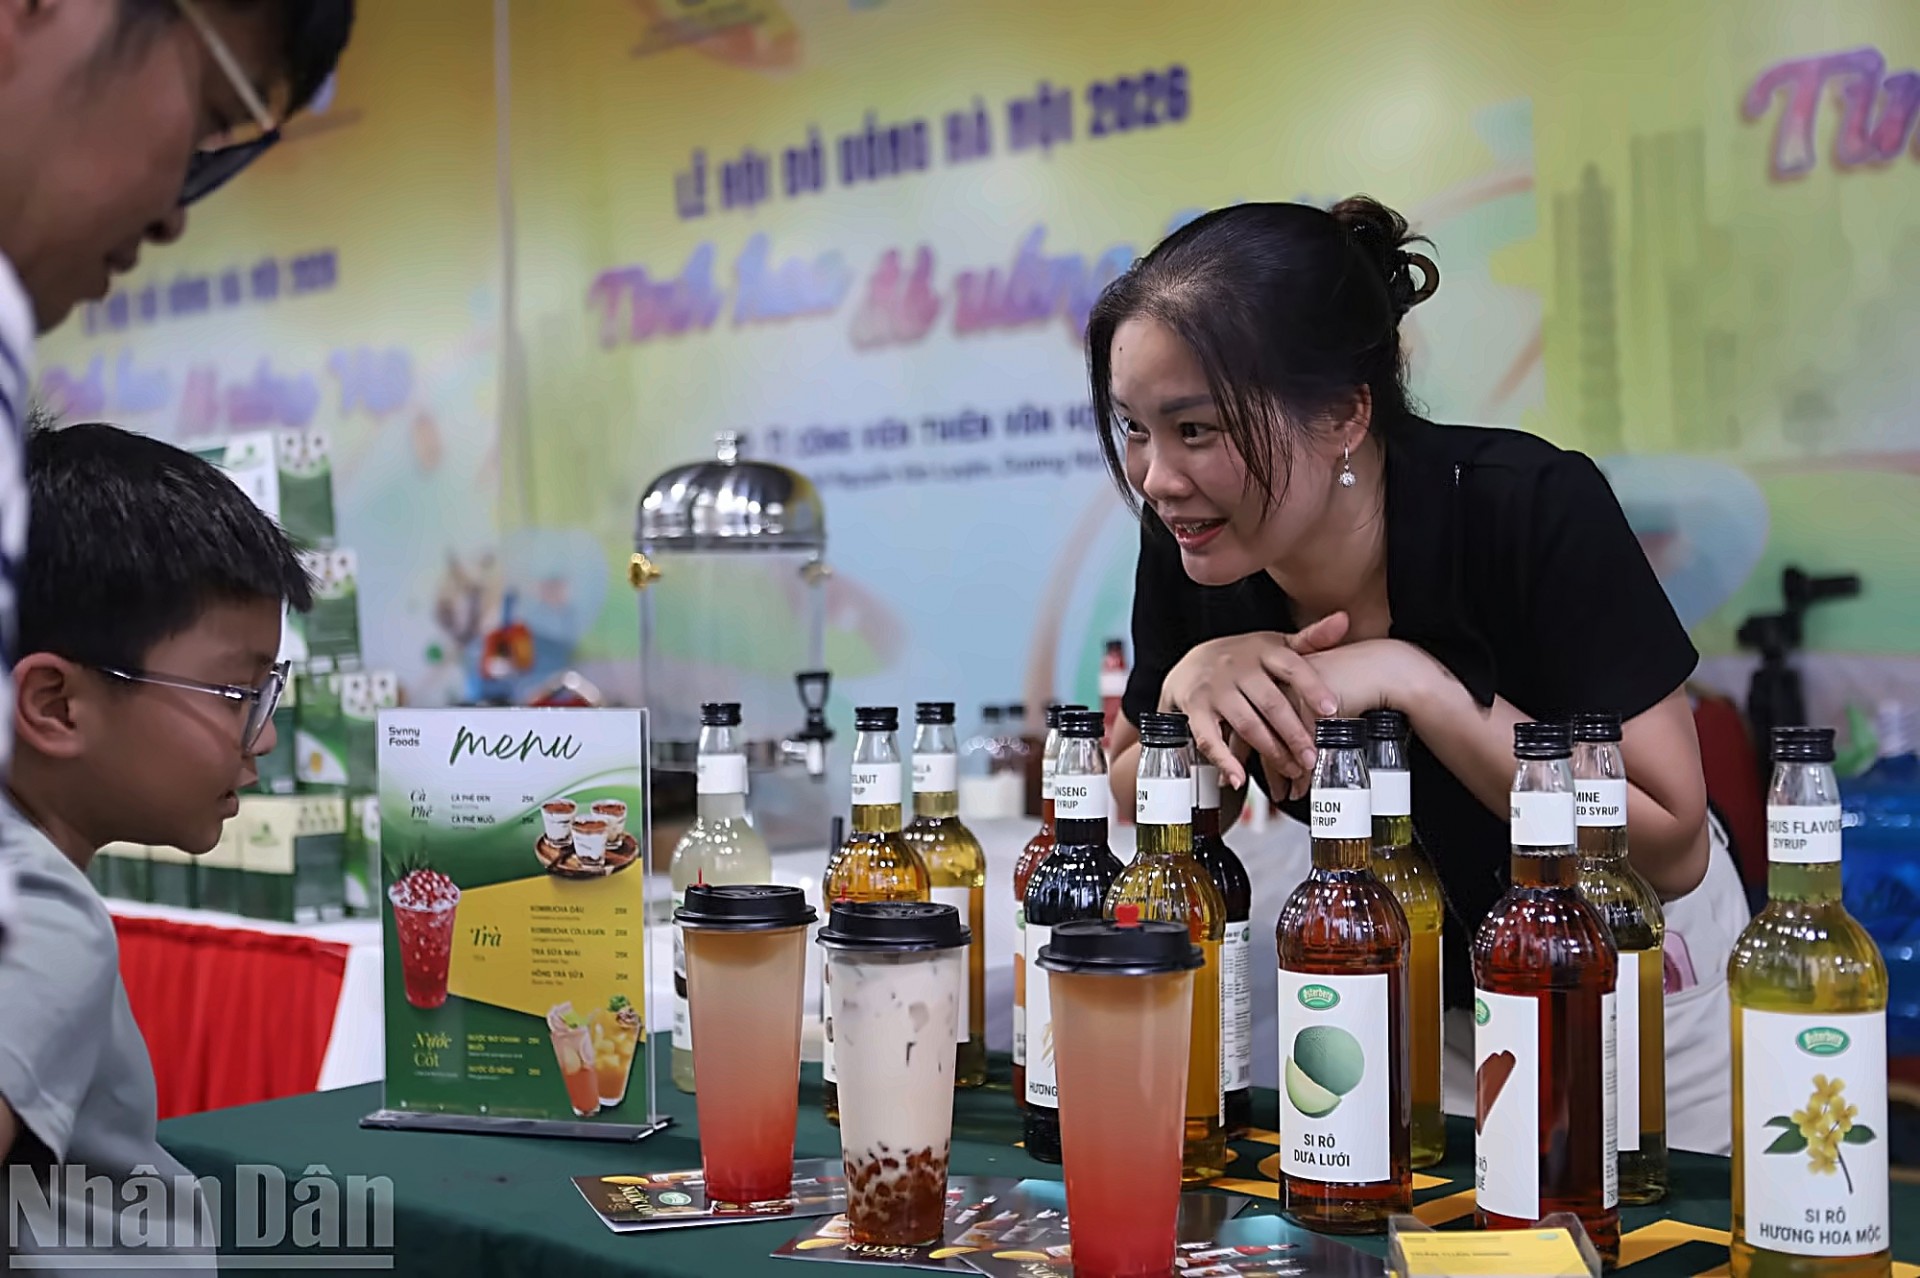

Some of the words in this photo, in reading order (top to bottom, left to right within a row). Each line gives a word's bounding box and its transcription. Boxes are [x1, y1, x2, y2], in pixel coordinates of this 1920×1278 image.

[1086, 63, 1190, 138] 2026
[389, 737, 420, 747] Foods
[449, 725, 582, 766] menu
[1589, 806, 1620, 816] SYRUP
[1773, 838, 1807, 850] SYRUP
[1304, 1133, 1315, 1147] SI
[1318, 1132, 1336, 1149] RÔ
[1294, 1149, 1316, 1165] DƯA
[1319, 1151, 1350, 1167] LƯỚI
[1805, 1208, 1820, 1224] SI
[1825, 1206, 1846, 1224] RÔ
[1759, 1223, 1814, 1244] HƯƠNG
[1819, 1230, 1852, 1245] HOA
[1856, 1223, 1881, 1244] MỘC
